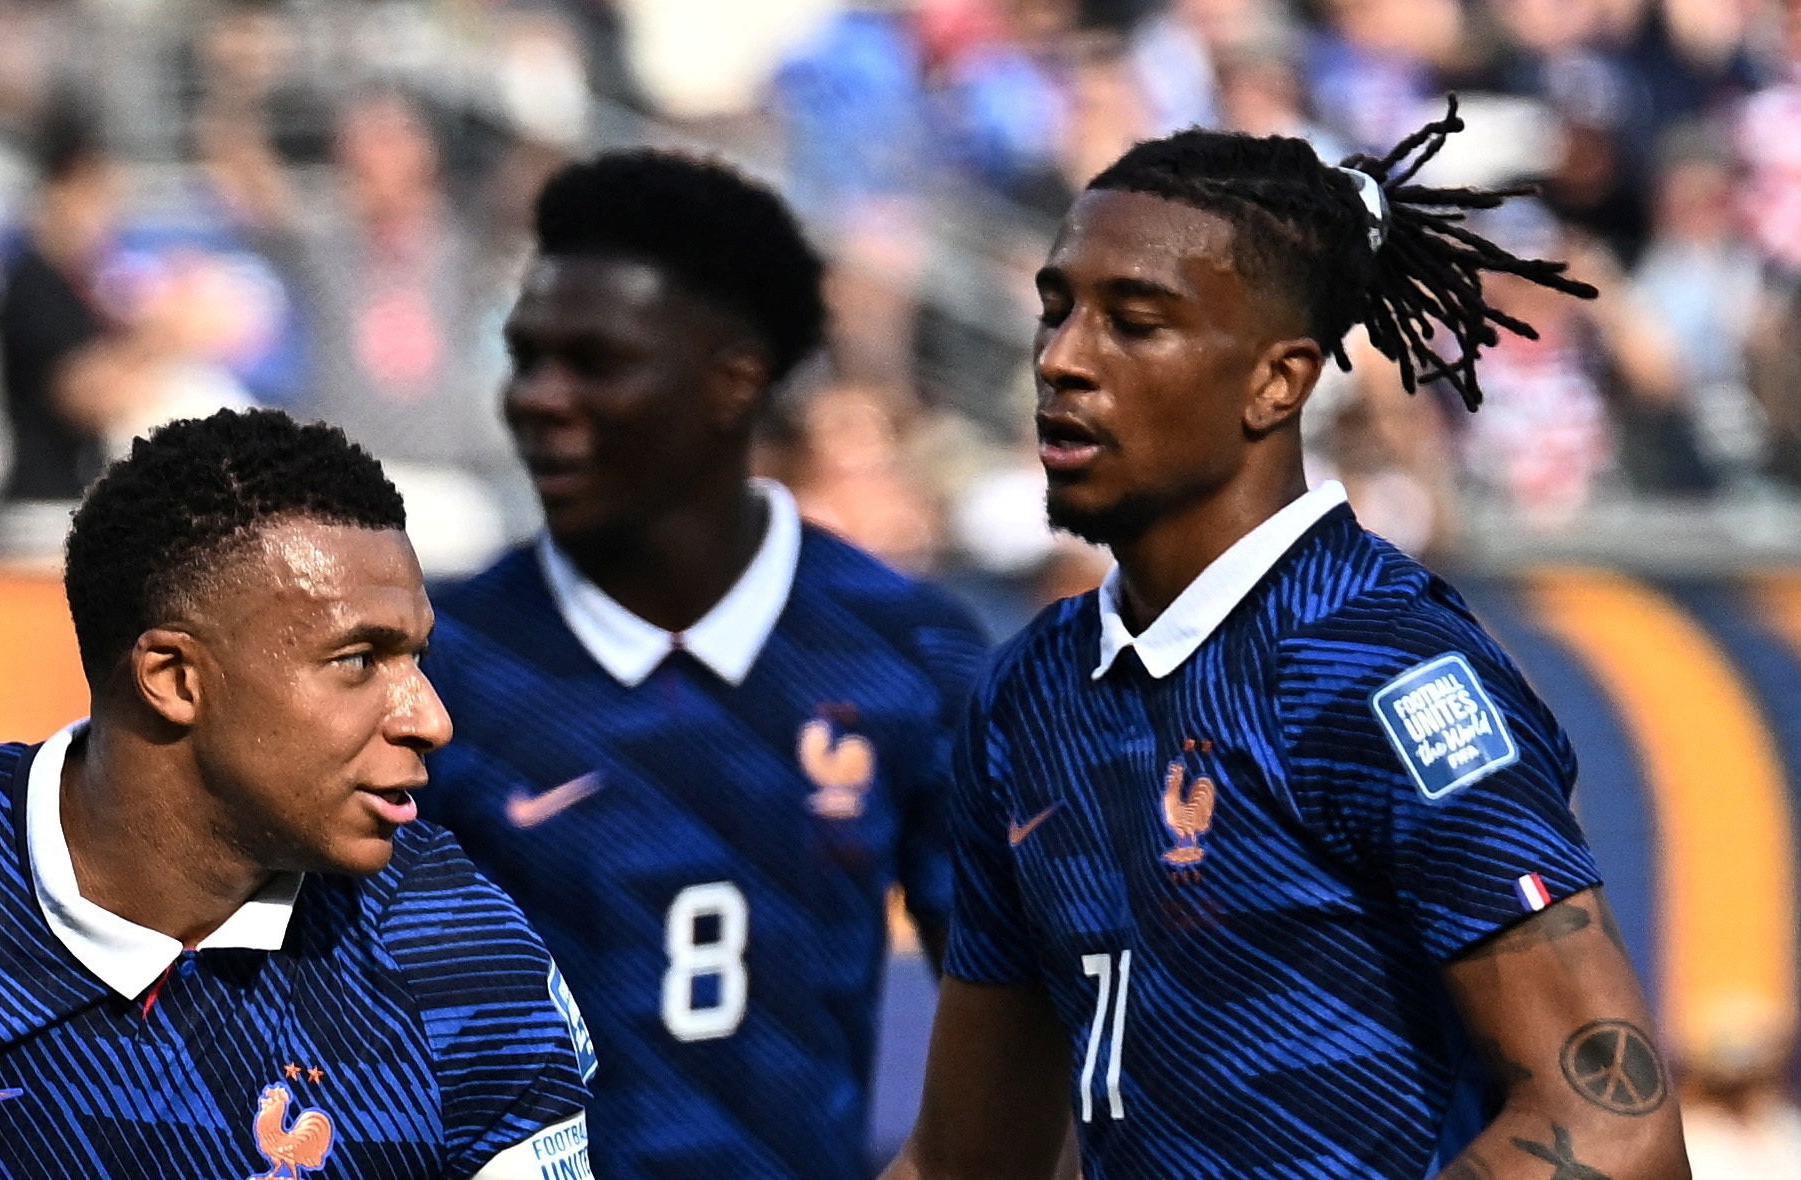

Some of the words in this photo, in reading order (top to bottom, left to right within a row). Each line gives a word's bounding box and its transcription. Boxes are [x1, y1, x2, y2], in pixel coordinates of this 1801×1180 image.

[1392, 673, 1465, 720] FOOTBALL
[1403, 690, 1479, 743] UNITES
[1415, 738, 1448, 767] the
[1441, 710, 1494, 752] World
[660, 880, 750, 1043] 8
[1080, 949, 1132, 1122] 11
